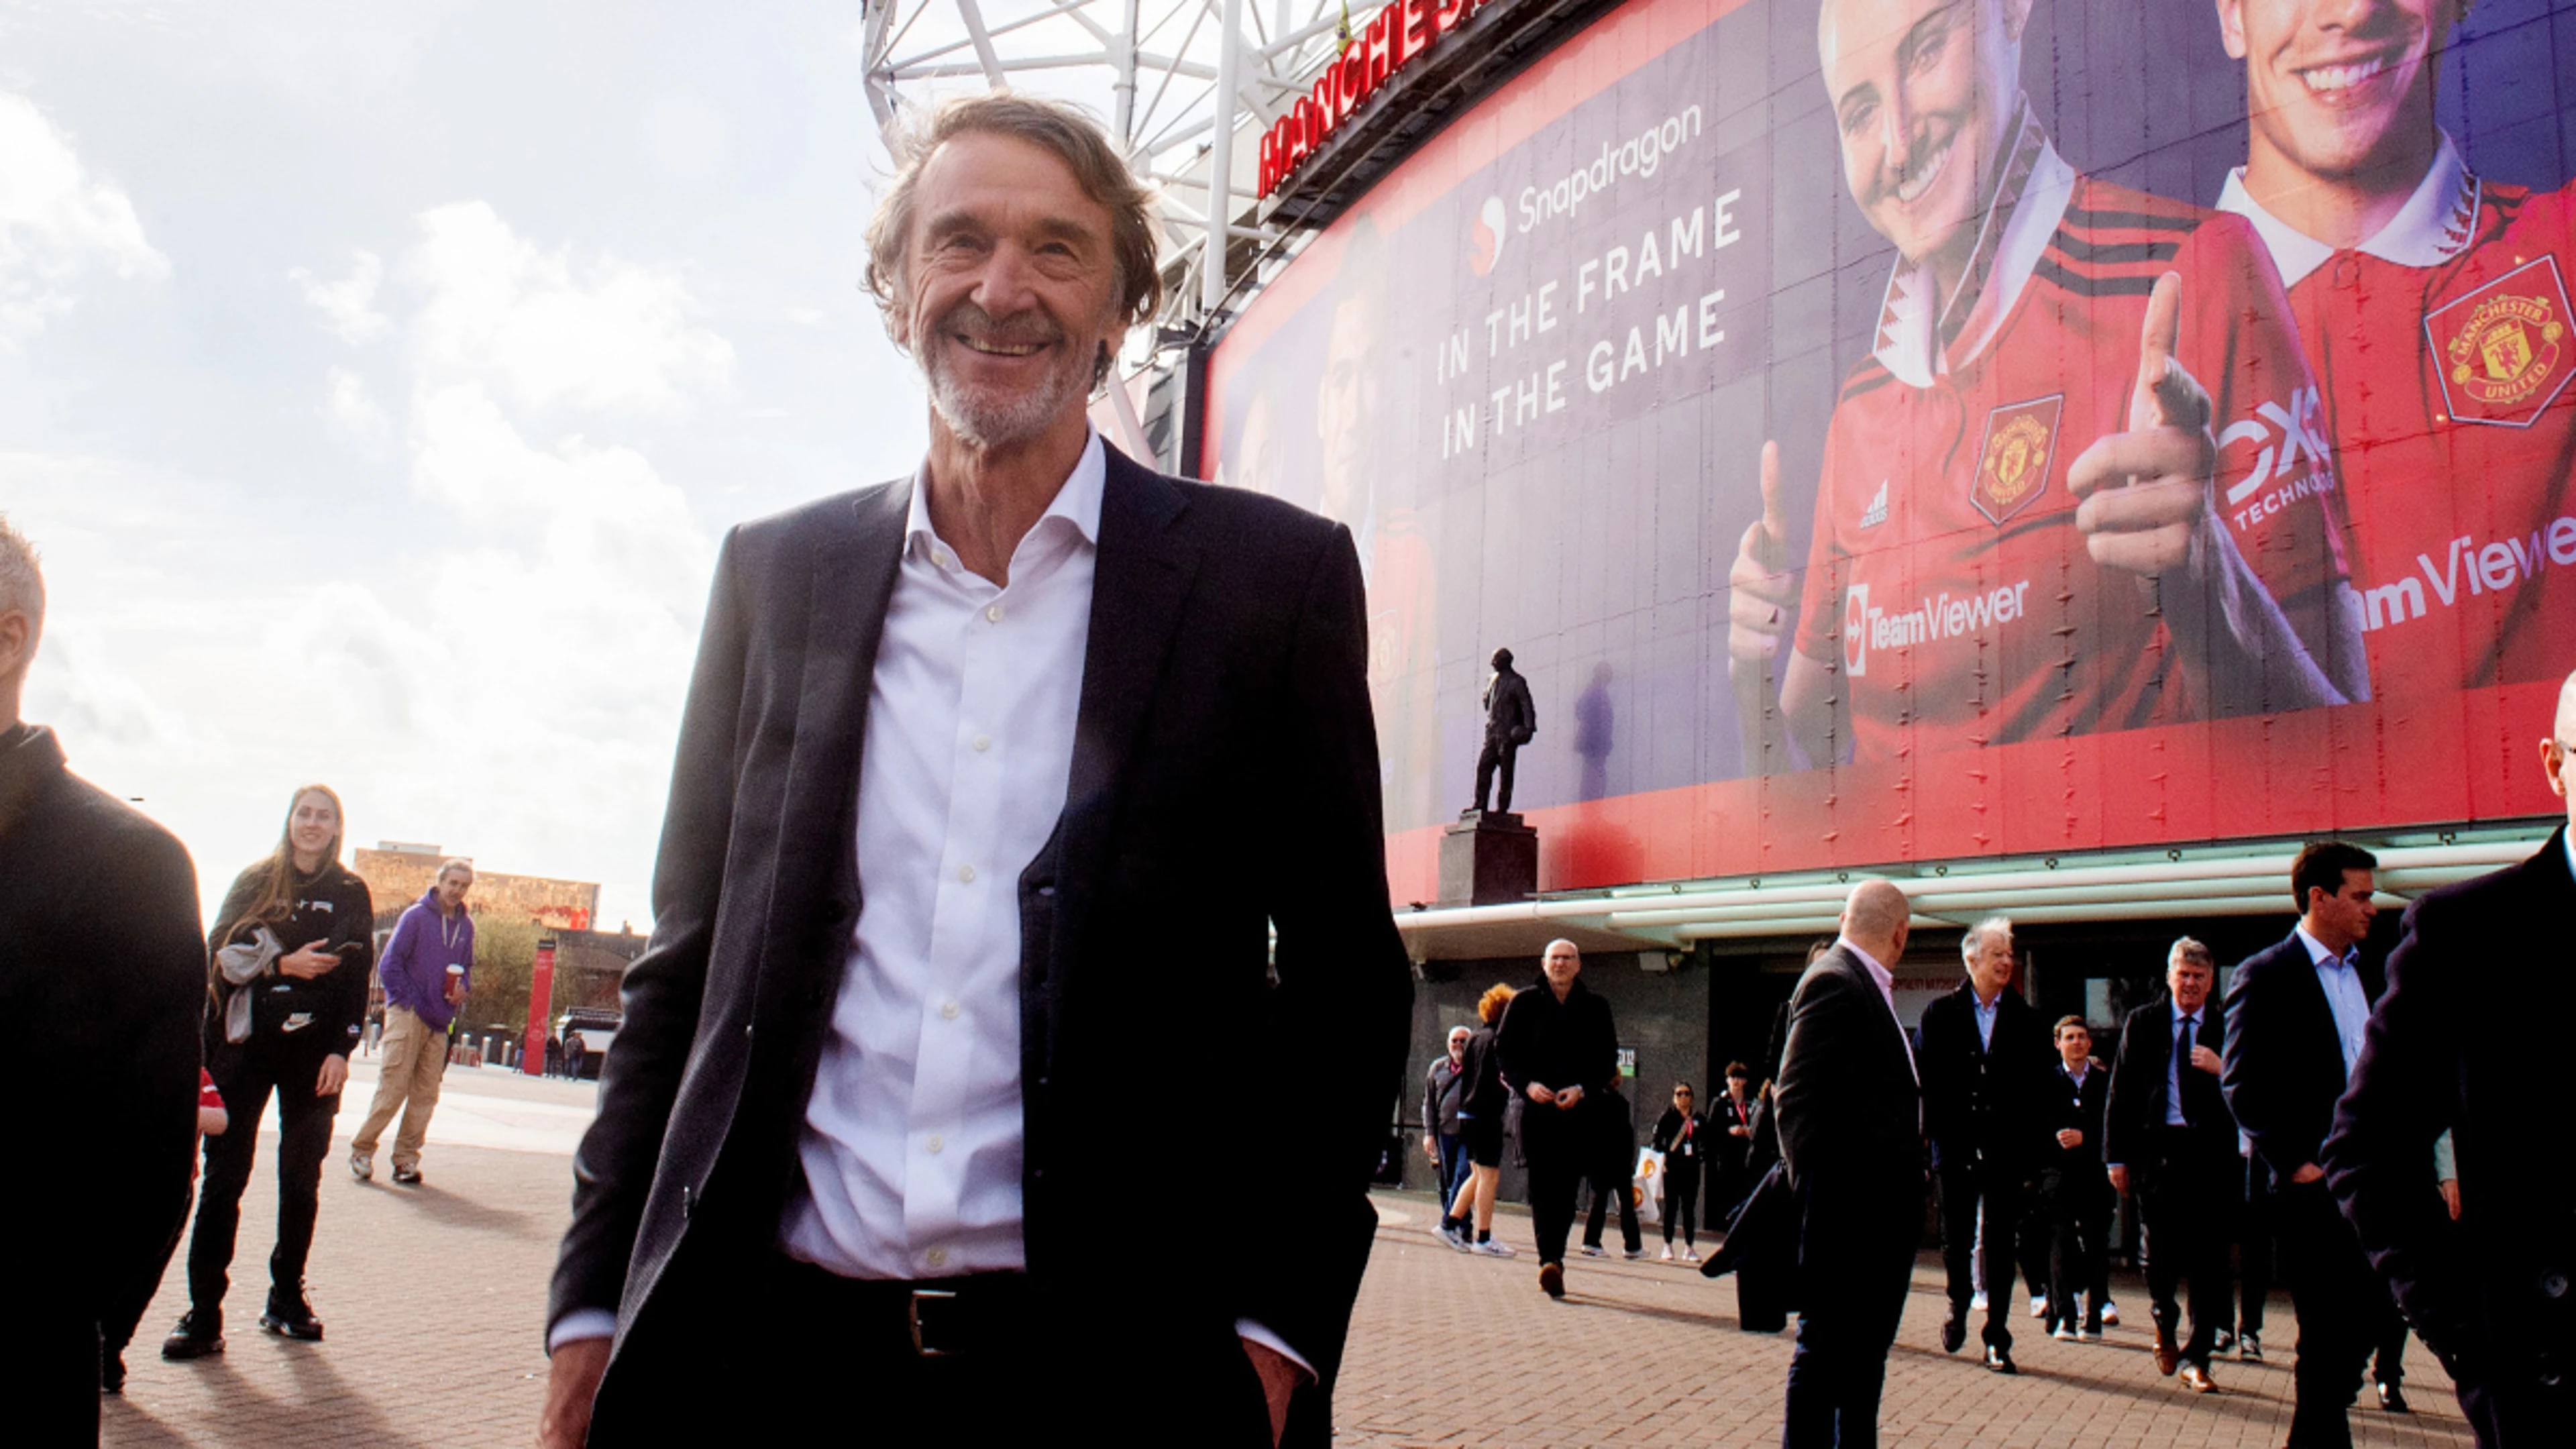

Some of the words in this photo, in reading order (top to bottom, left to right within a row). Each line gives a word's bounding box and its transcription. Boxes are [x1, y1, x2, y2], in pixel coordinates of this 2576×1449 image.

[1518, 105, 1701, 233] Snapdragon
[1438, 328, 1469, 385] IN
[1485, 280, 1558, 357] THE
[1577, 189, 1741, 314] FRAME
[2458, 301, 2543, 356] MANCHESTER
[1443, 403, 1475, 460] IN
[1492, 360, 1567, 435] THE
[1586, 289, 1725, 393] GAME
[2484, 362, 2547, 398] UNITED
[1868, 580, 2029, 649] TeamViewer
